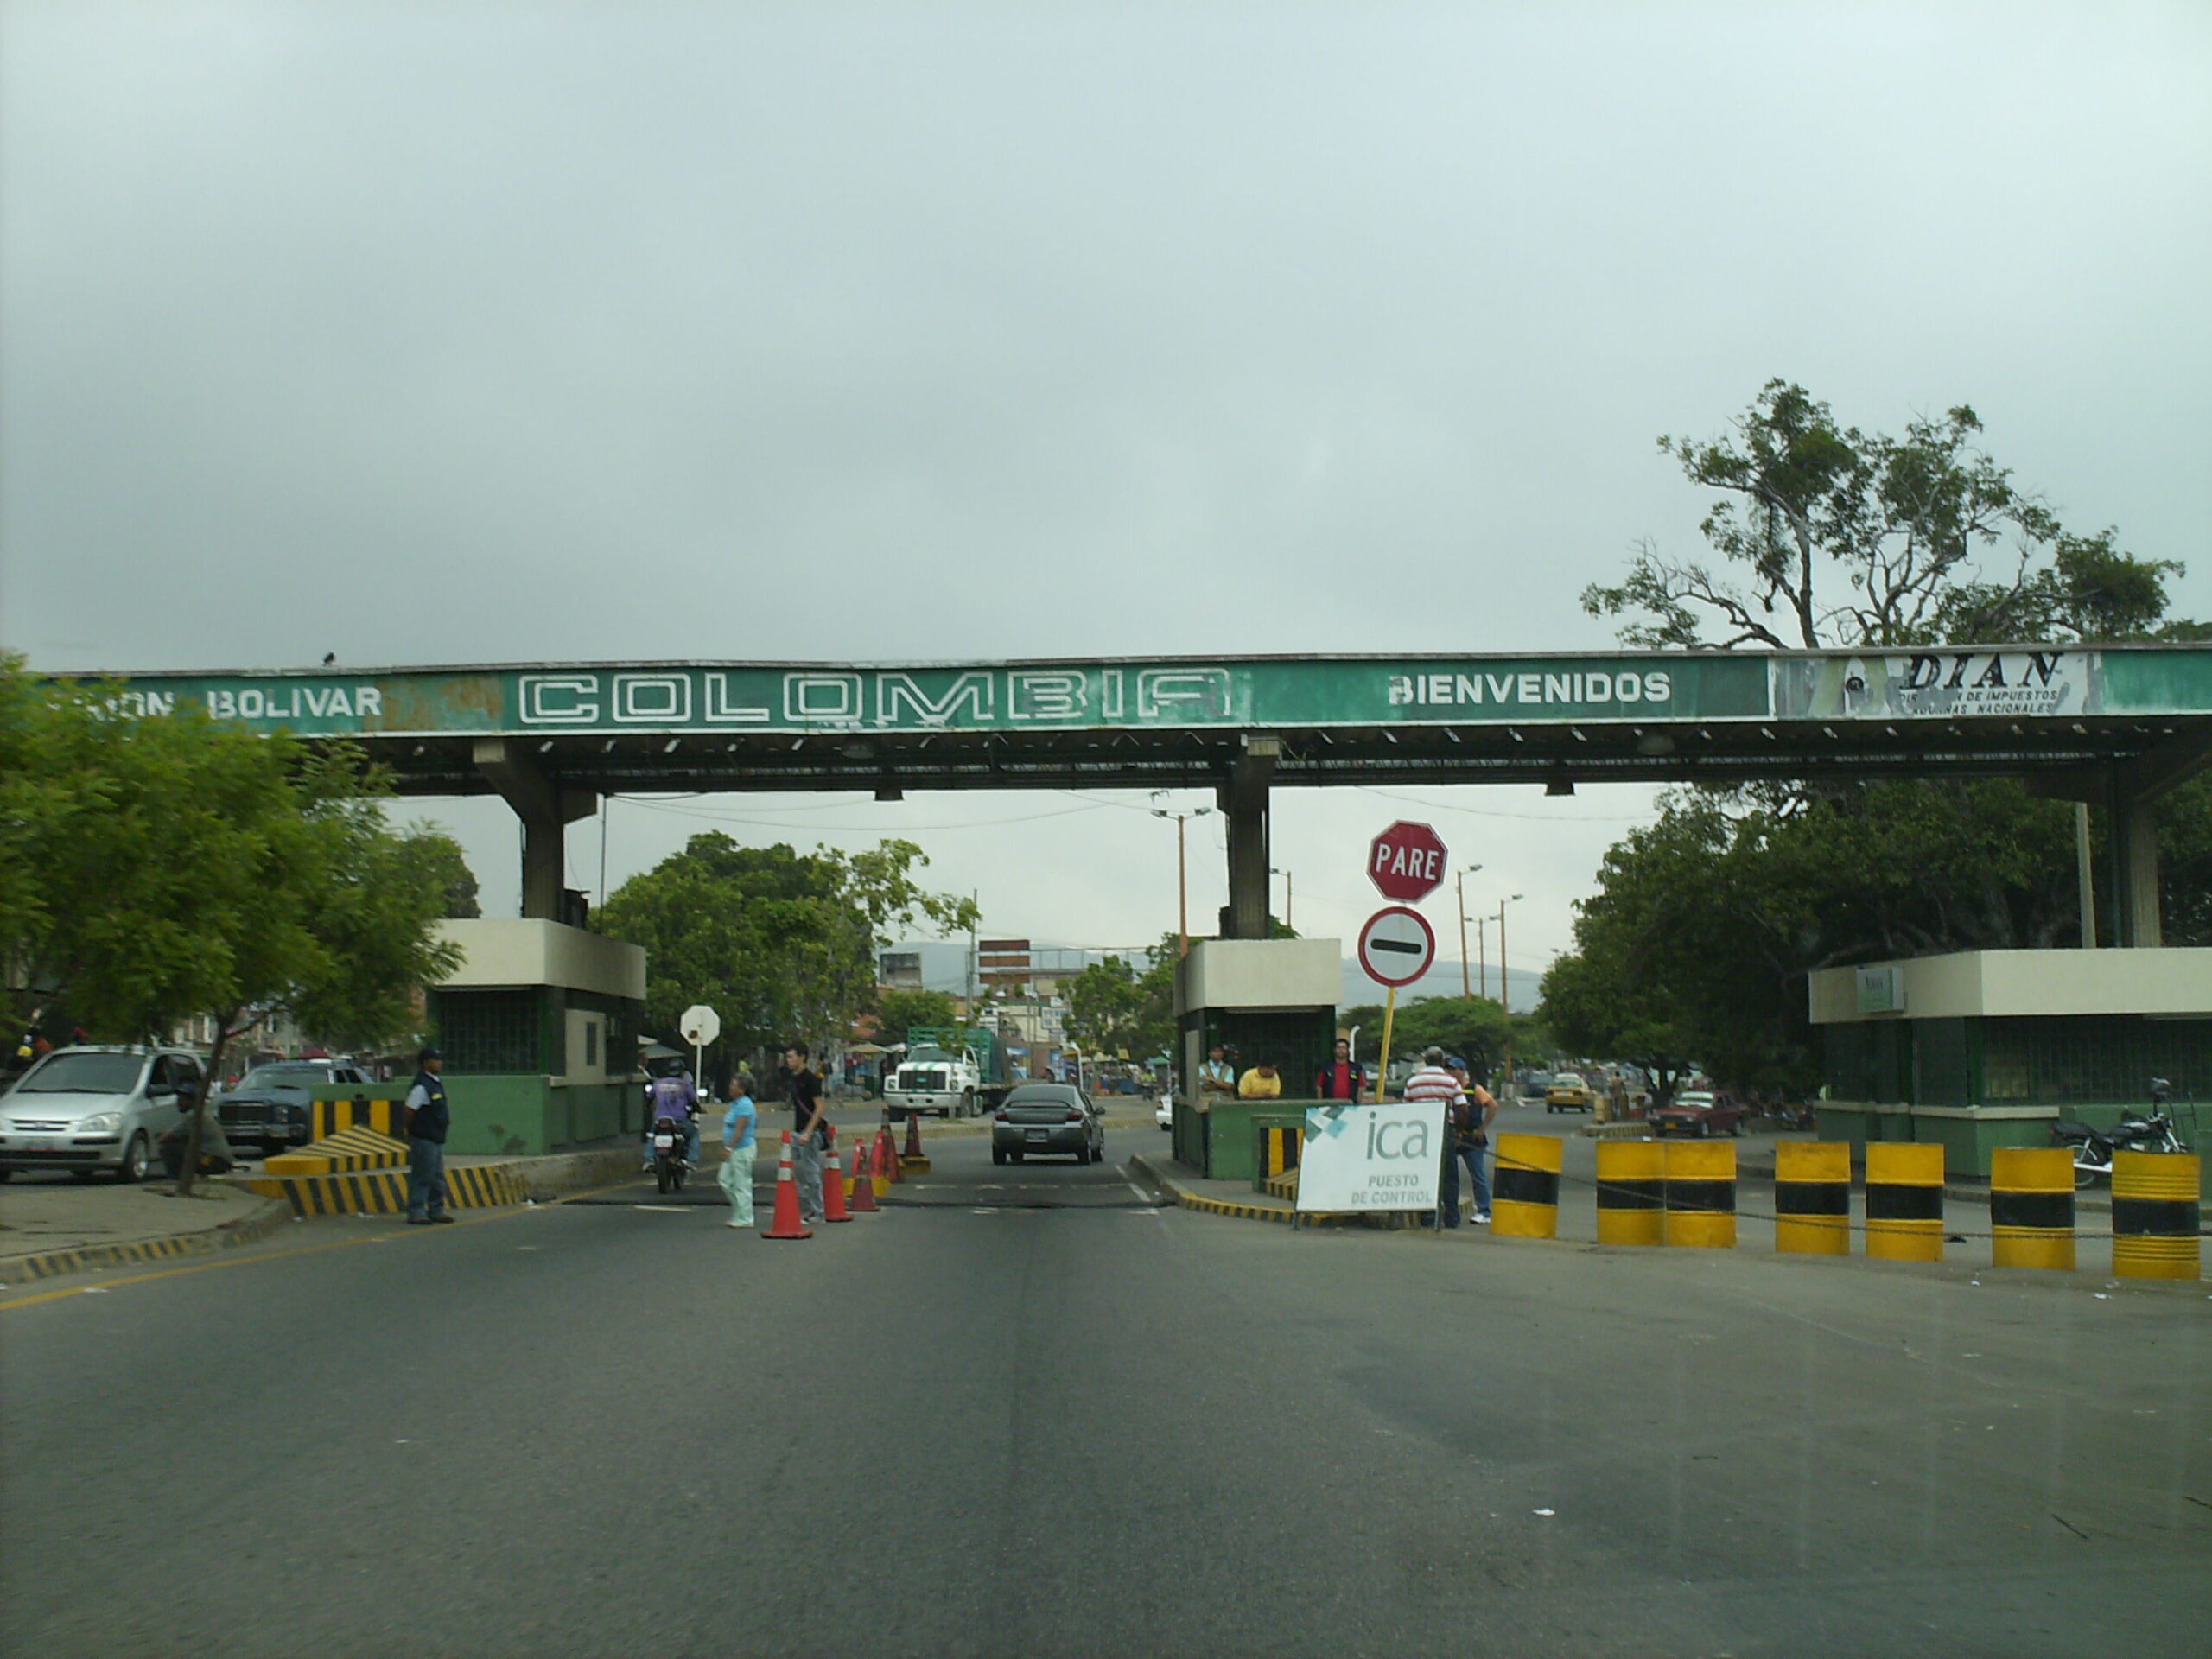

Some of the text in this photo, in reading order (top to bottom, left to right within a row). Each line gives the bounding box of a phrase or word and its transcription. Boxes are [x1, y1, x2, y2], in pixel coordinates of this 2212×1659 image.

[1899, 651, 2064, 690] DIAN
[207, 687, 382, 720] BOLIVAR
[519, 667, 1231, 724] COLOMBIA
[1389, 671, 1670, 704] BIENVENIDOS
[1967, 692, 1982, 702] DE
[1986, 690, 2056, 701] IMPUESTOS
[1977, 702, 2054, 714] NACIONALES
[1376, 843, 1439, 880] PARE
[1367, 1111, 1428, 1160] ica
[1368, 1175, 1419, 1187] PUESTO
[1351, 1191, 1432, 1205] DE CONTROL
